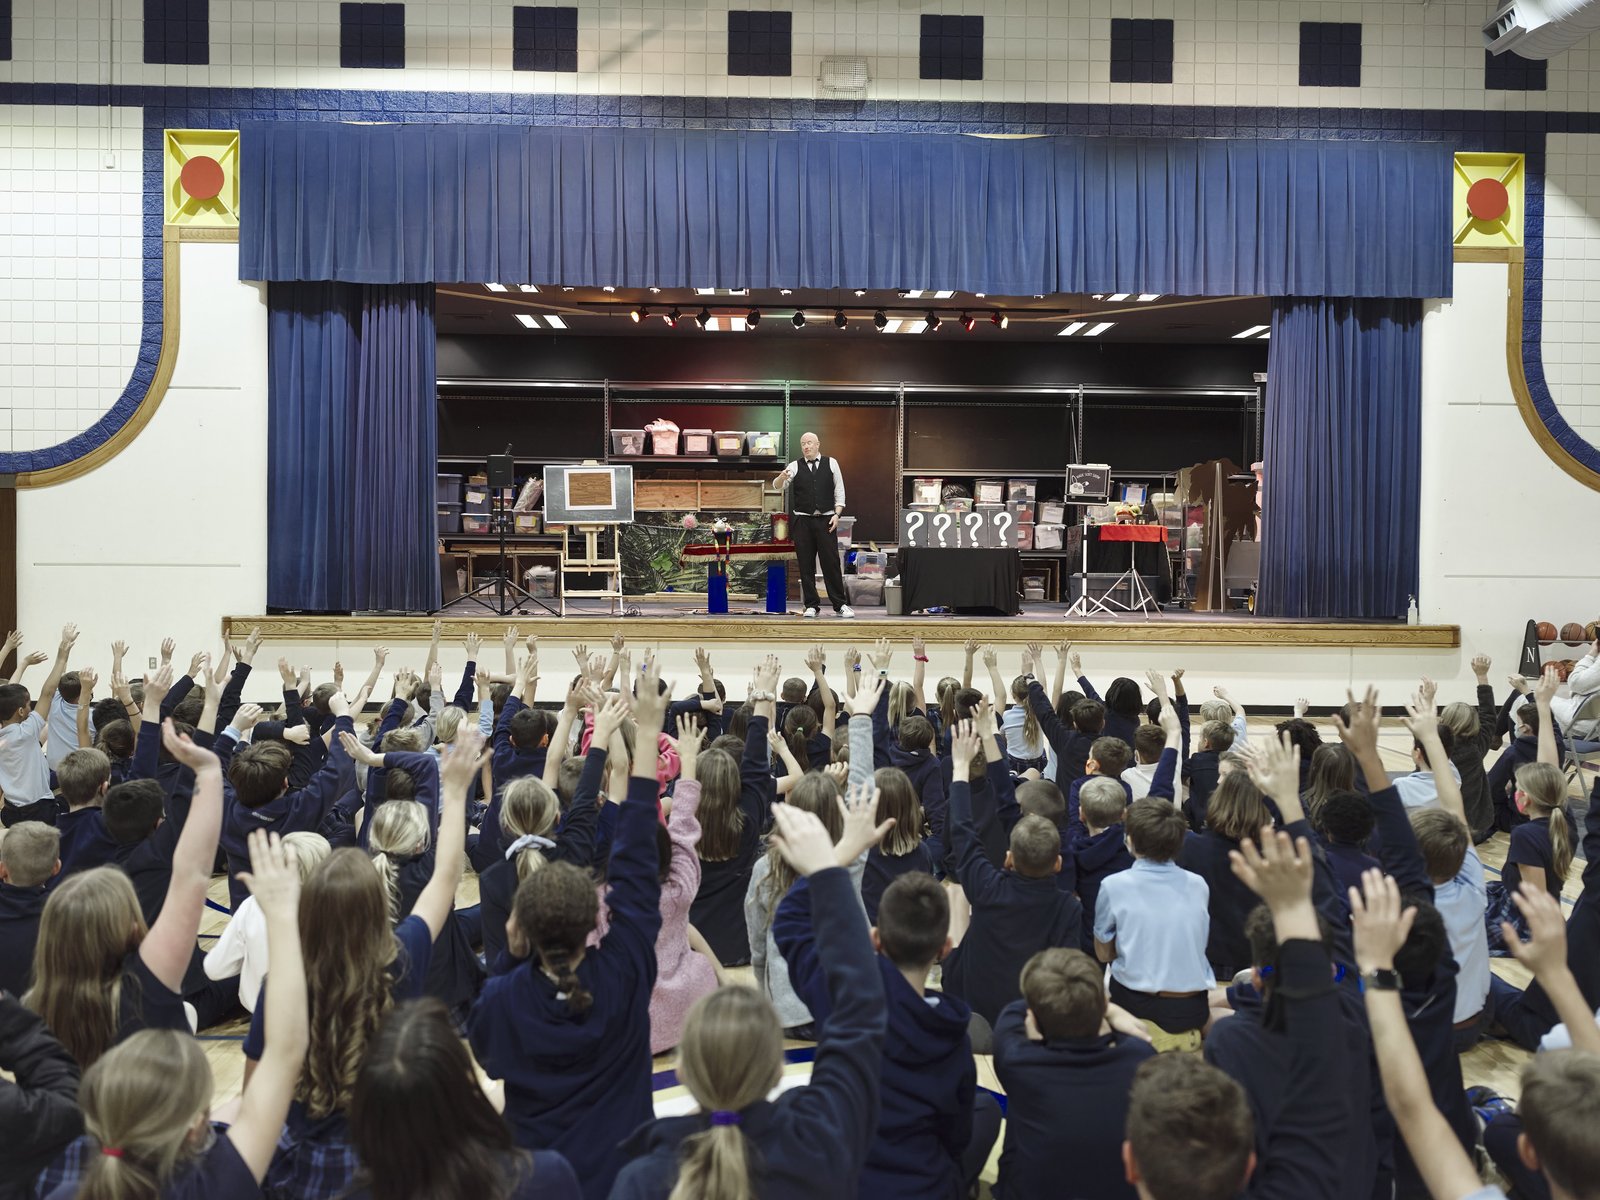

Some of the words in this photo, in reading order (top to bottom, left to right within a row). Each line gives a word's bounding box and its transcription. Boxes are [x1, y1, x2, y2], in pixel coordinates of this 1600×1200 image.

[905, 511, 924, 547] ?
[932, 513, 952, 548] ?
[964, 512, 983, 548] ?
[993, 511, 1013, 547] ?
[1526, 646, 1535, 663] N
